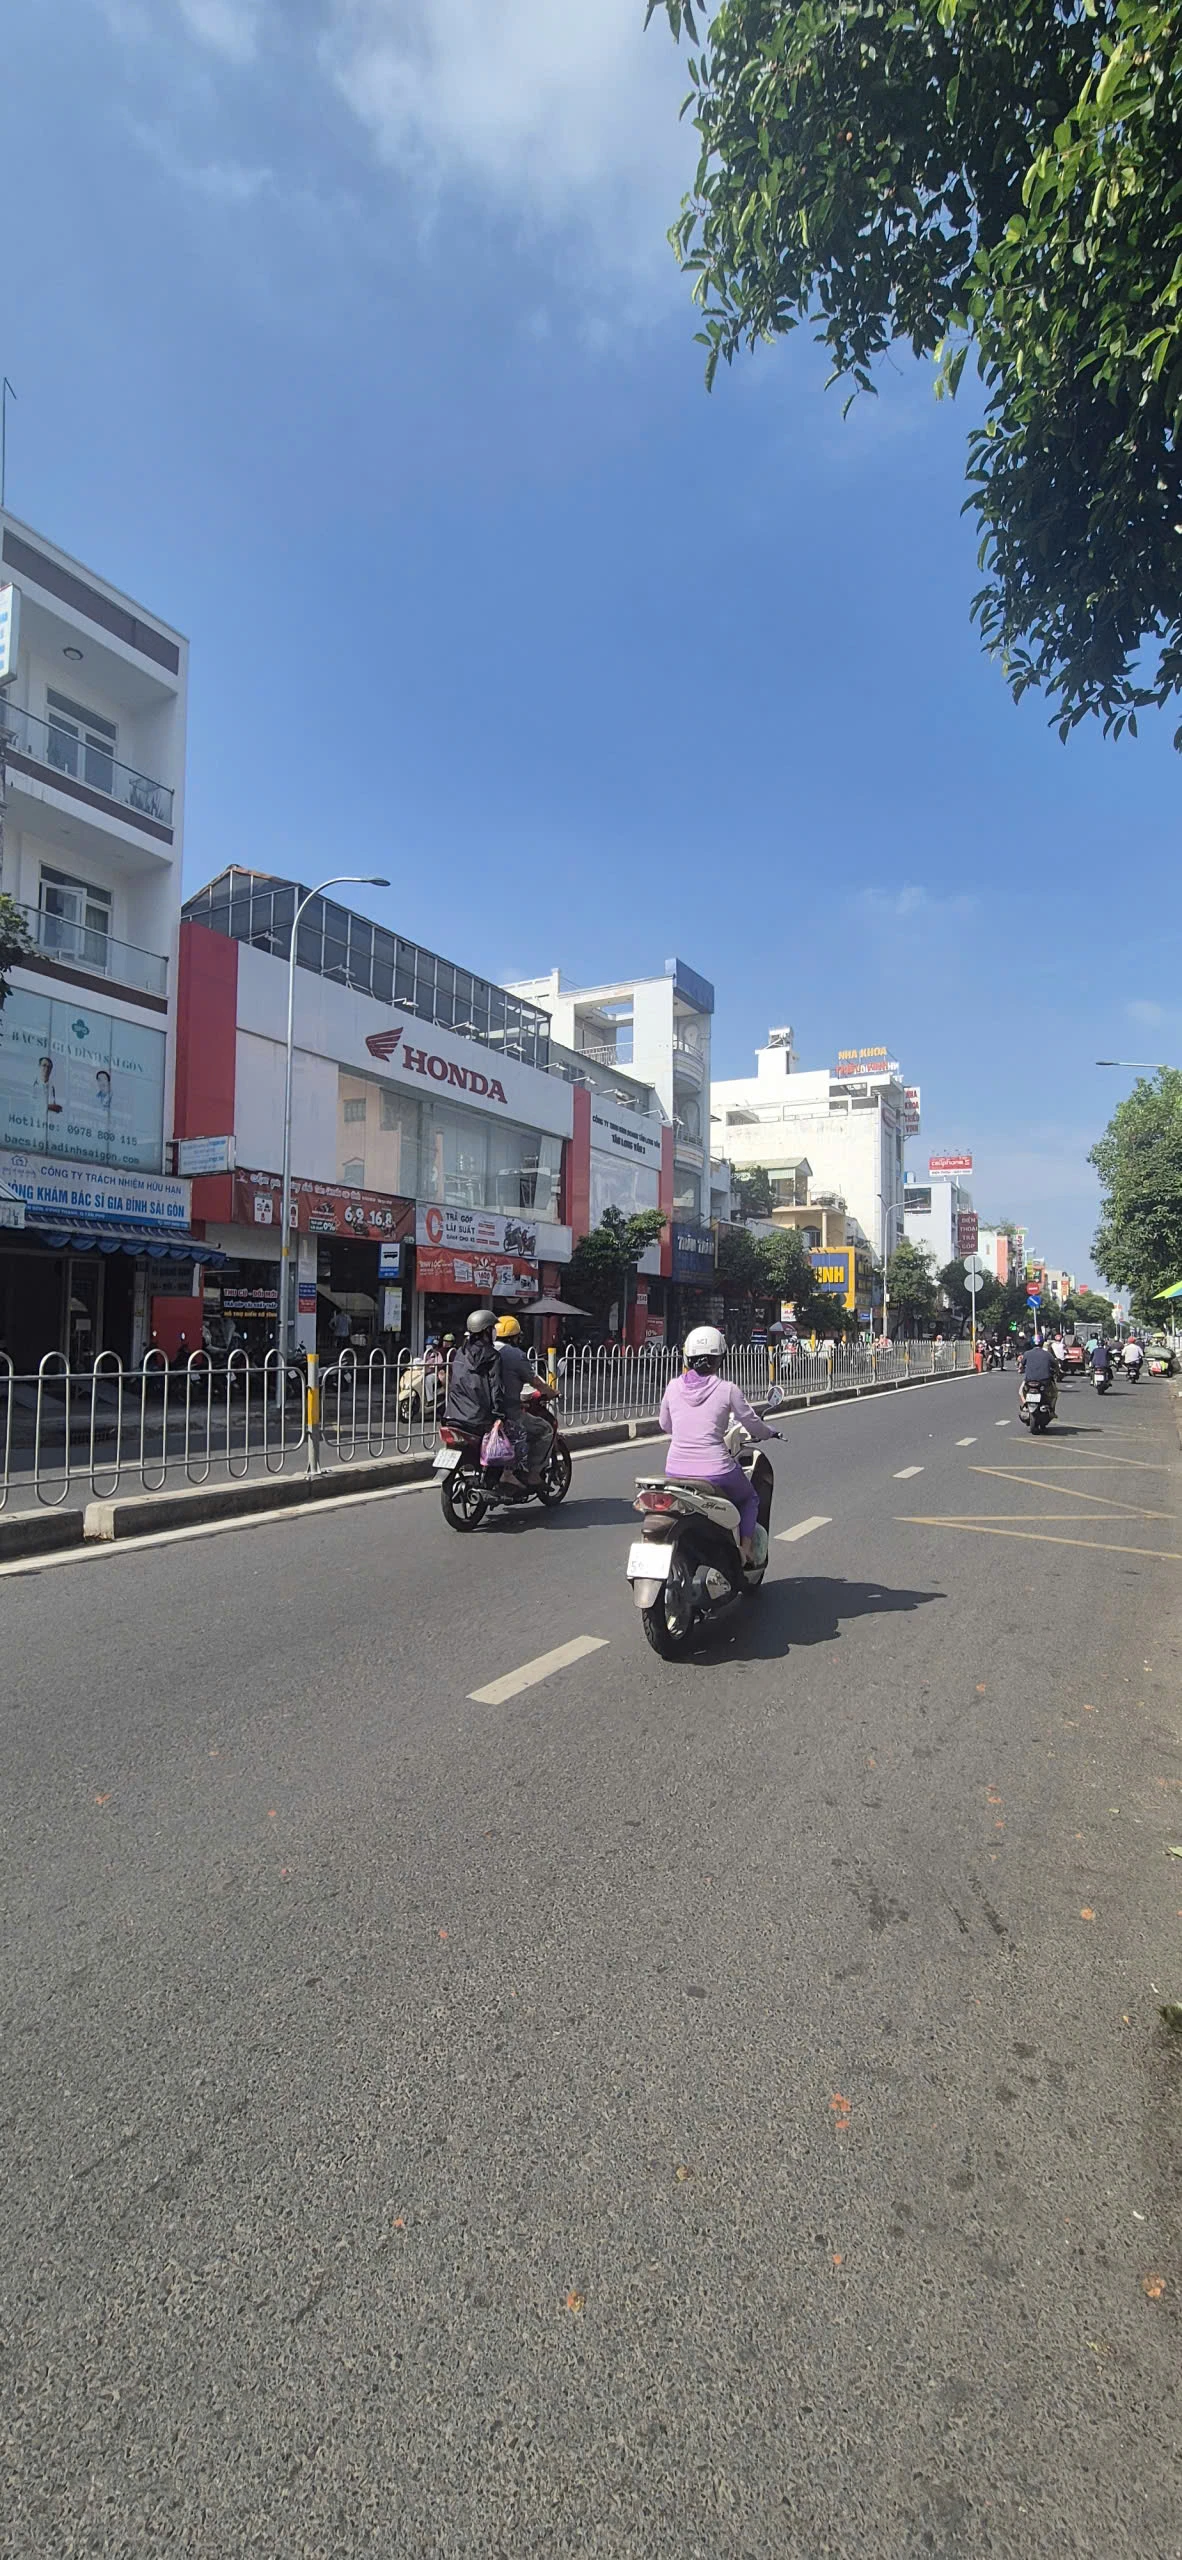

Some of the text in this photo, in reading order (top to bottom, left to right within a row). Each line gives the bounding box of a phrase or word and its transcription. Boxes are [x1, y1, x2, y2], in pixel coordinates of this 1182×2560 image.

[838, 1047, 887, 1059] NHA KHOA
[402, 1044, 508, 1104] HONDA
[9, 1114, 138, 1146] Hotline: 0978 800 115
[4, 1133, 140, 1164] bacsigiadinhsaigon.com
[40, 1165, 69, 1180] CÔNG
[71, 1170, 83, 1180] TY
[86, 1171, 116, 1185] TRÁCH
[118, 1177, 144, 1190] NHIỆM
[165, 1185, 182, 1195] HẠN
[37, 1186, 68, 1205] KHÁM
[71, 1189, 91, 1207] BÁC
[94, 1194, 104, 1208] SĨ
[108, 1195, 123, 1211] GIA
[126, 1197, 147, 1213] ĐÌNH
[150, 1200, 164, 1215] SÀI
[167, 1201, 184, 1217] GÒN
[446, 1211, 458, 1222] TRẢ
[223, 1288, 237, 1297] THU
